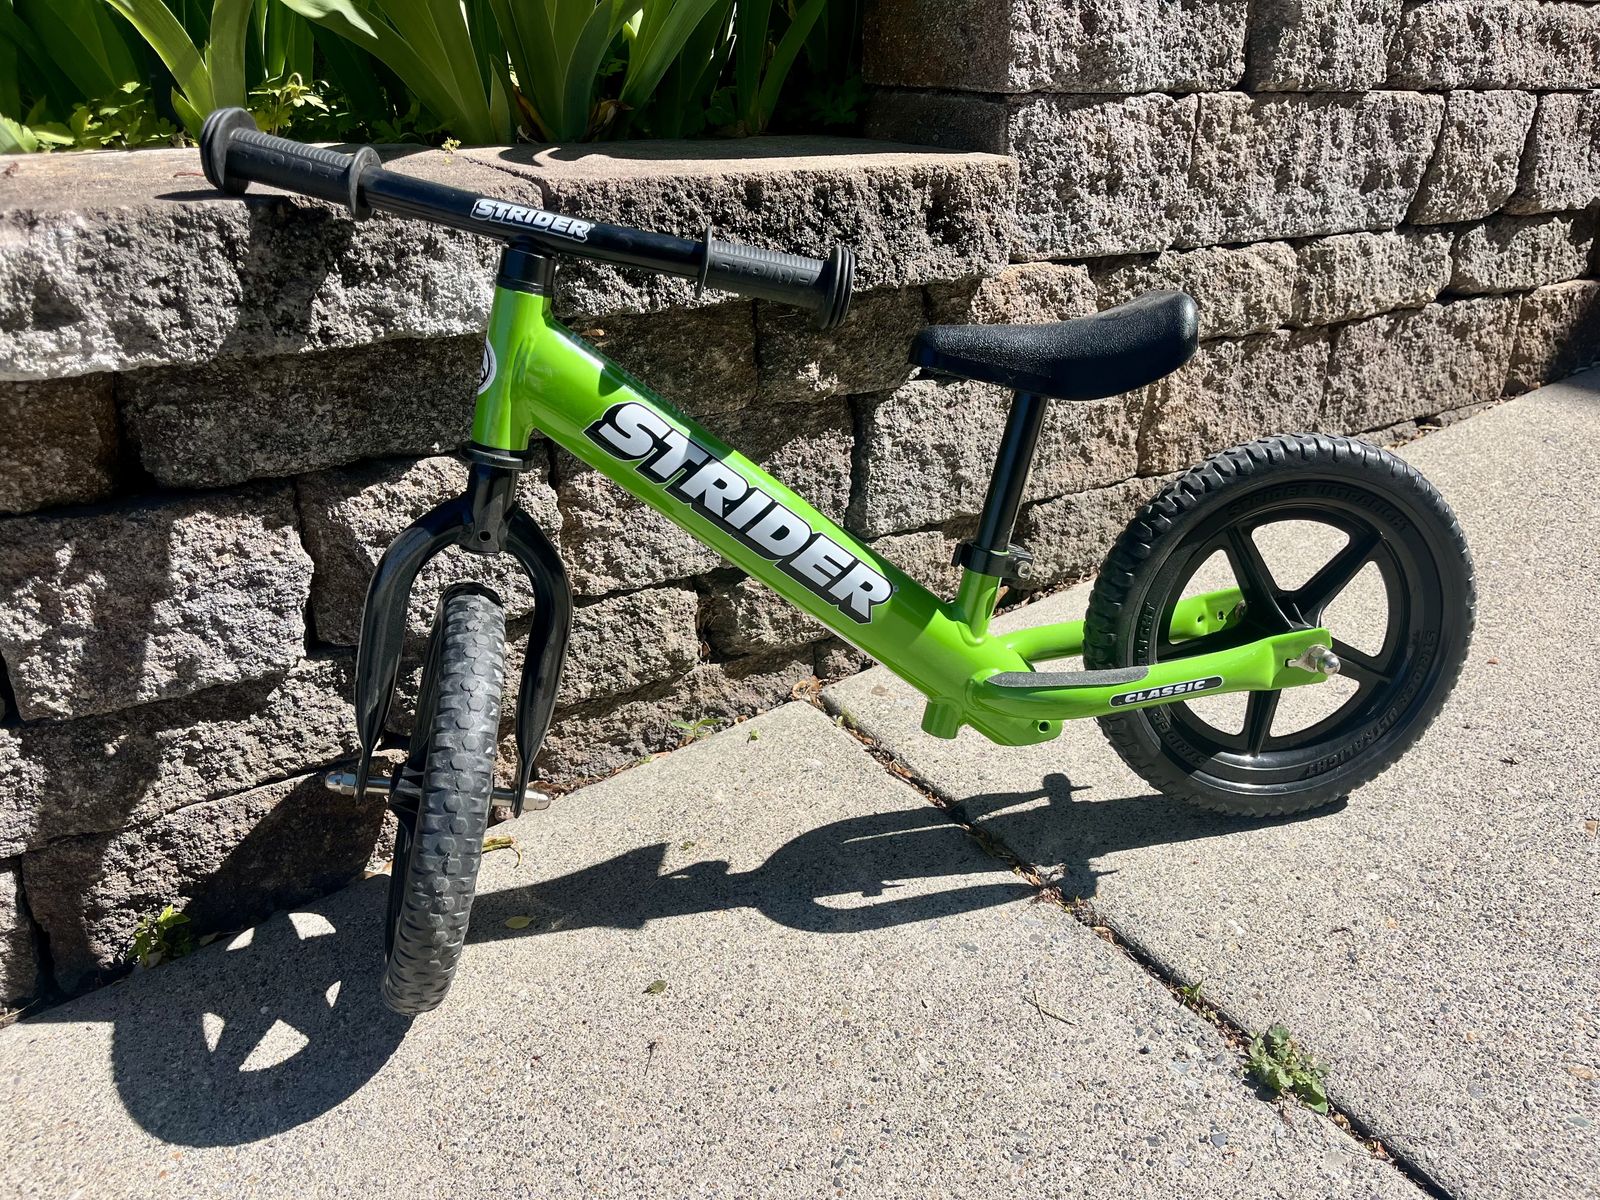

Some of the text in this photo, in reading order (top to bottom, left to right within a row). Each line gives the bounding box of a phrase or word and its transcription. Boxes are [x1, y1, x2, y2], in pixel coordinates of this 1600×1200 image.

[472, 198, 591, 241] STRIDER
[590, 402, 894, 623] STRIDER
[1124, 680, 1206, 704] CLASSIC
